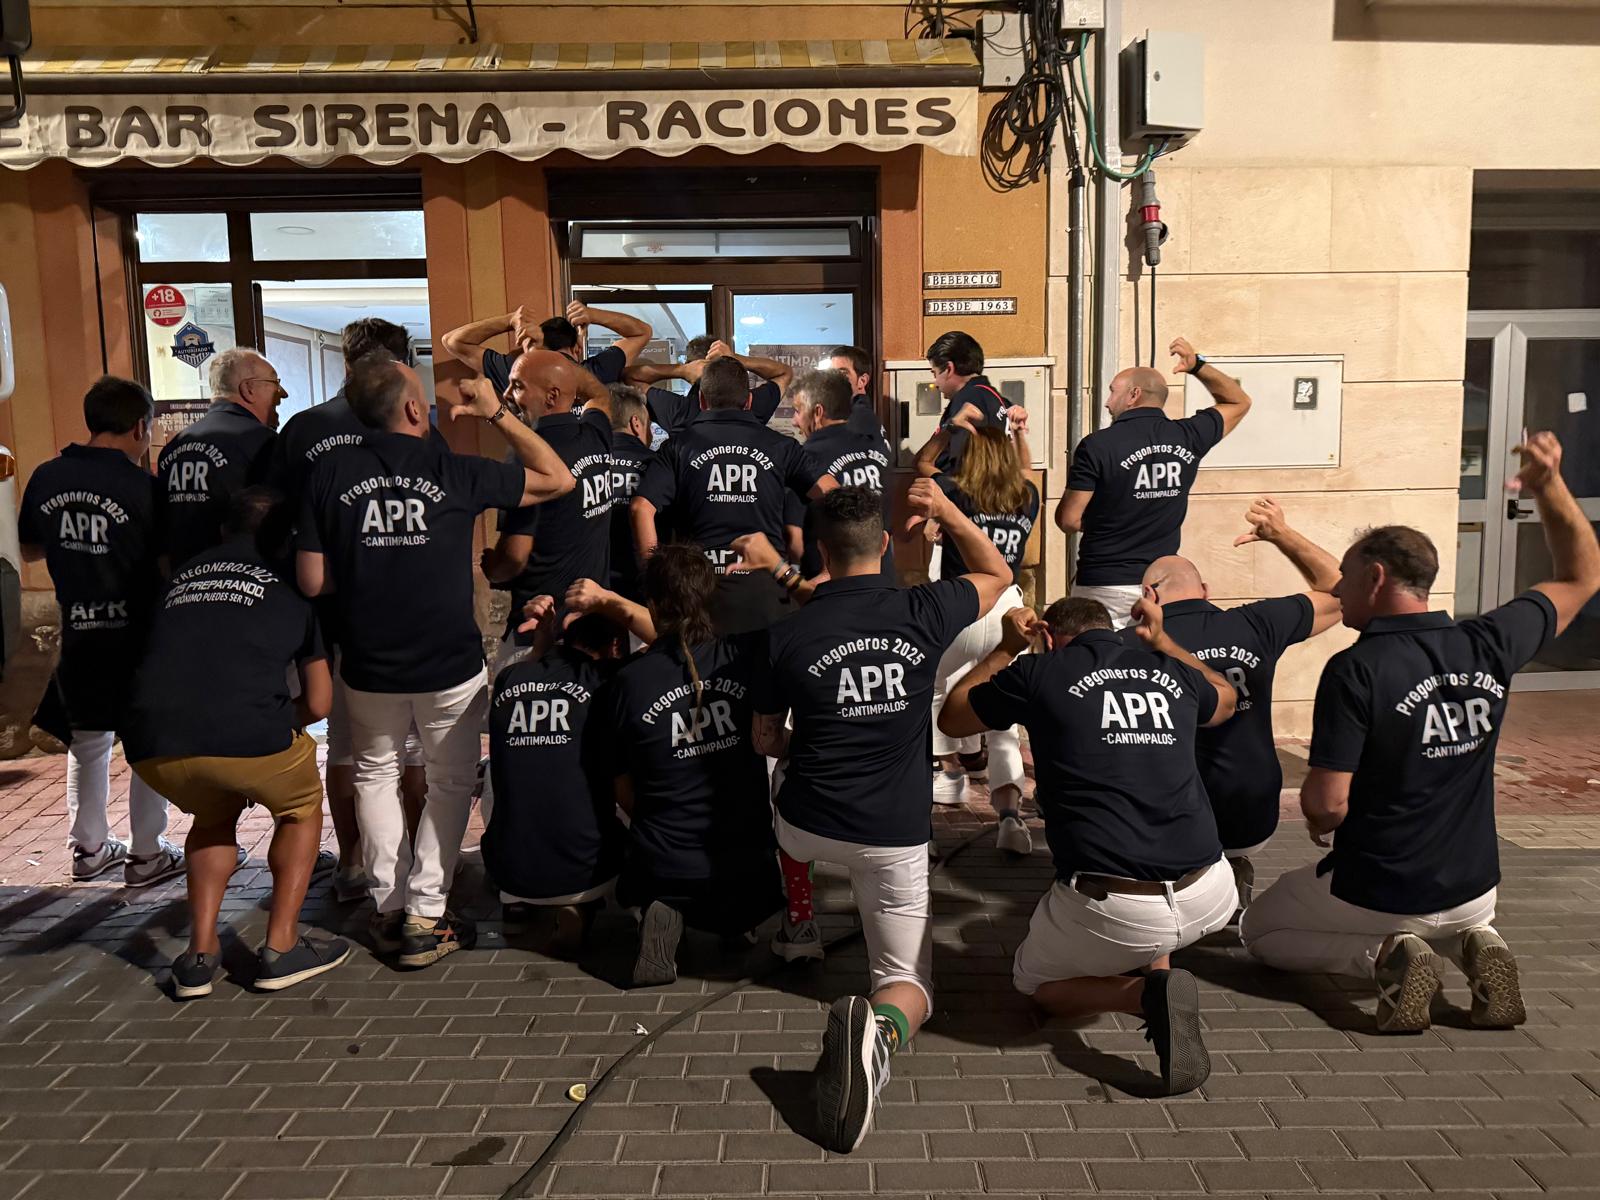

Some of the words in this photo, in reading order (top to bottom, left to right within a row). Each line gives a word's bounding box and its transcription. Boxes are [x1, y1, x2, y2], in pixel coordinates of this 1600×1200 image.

[64, 105, 212, 149] BAR
[253, 102, 511, 147] SIRENA
[606, 96, 957, 141] RACIONES
[933, 274, 993, 285] BEBERCIO
[151, 288, 176, 303] +18
[933, 302, 971, 311] DESDE
[978, 301, 1008, 311] 1963
[205, 444, 229, 469] 2025
[305, 434, 363, 462] Pregonero
[690, 445, 749, 470] Pregoneros
[750, 448, 775, 471] 2025
[1120, 445, 1173, 470] Pregoneros
[1173, 445, 1195, 465] 2025
[168, 461, 209, 491] APR
[827, 451, 868, 477] regoneros
[1134, 462, 1181, 490] APR
[339, 475, 411, 507] Pregoneros
[413, 477, 447, 503] 2025
[612, 472, 640, 496] PR
[707, 463, 758, 493] APR
[40, 491, 101, 515] Pregoneros
[100, 497, 129, 524] 2025
[706, 494, 758, 503] -CANTIMPALOS-
[1133, 489, 1181, 499] -CANTIMPALOS-
[60, 510, 109, 543] APR
[361, 499, 428, 533] APR
[172, 562, 252, 585] PREGONEROS
[202, 592, 229, 602] PUEDES
[229, 593, 243, 604] SER
[808, 637, 889, 677] Pregoneros
[892, 638, 926, 666] 2025
[1230, 645, 1261, 669] 2025
[561, 682, 592, 703] 2025
[837, 662, 907, 704] APR
[1068, 668, 1147, 698] Pregoneros
[1151, 669, 1184, 699] 2025
[1395, 672, 1469, 716] Pregoneros
[1472, 671, 1505, 699] 2025
[641, 679, 711, 725] Pregoneros
[714, 677, 747, 700] 2025
[837, 699, 910, 718] -CANTIMPALOS-
[1101, 690, 1175, 729] APR
[507, 698, 571, 733] APR
[671, 699, 737, 747] APR
[1421, 697, 1493, 744] APR
[506, 734, 572, 746] -CANTIMPALOS-
[672, 735, 741, 759] -CANTIMPALOS-
[1101, 732, 1177, 745] -CANTIMPALOS-
